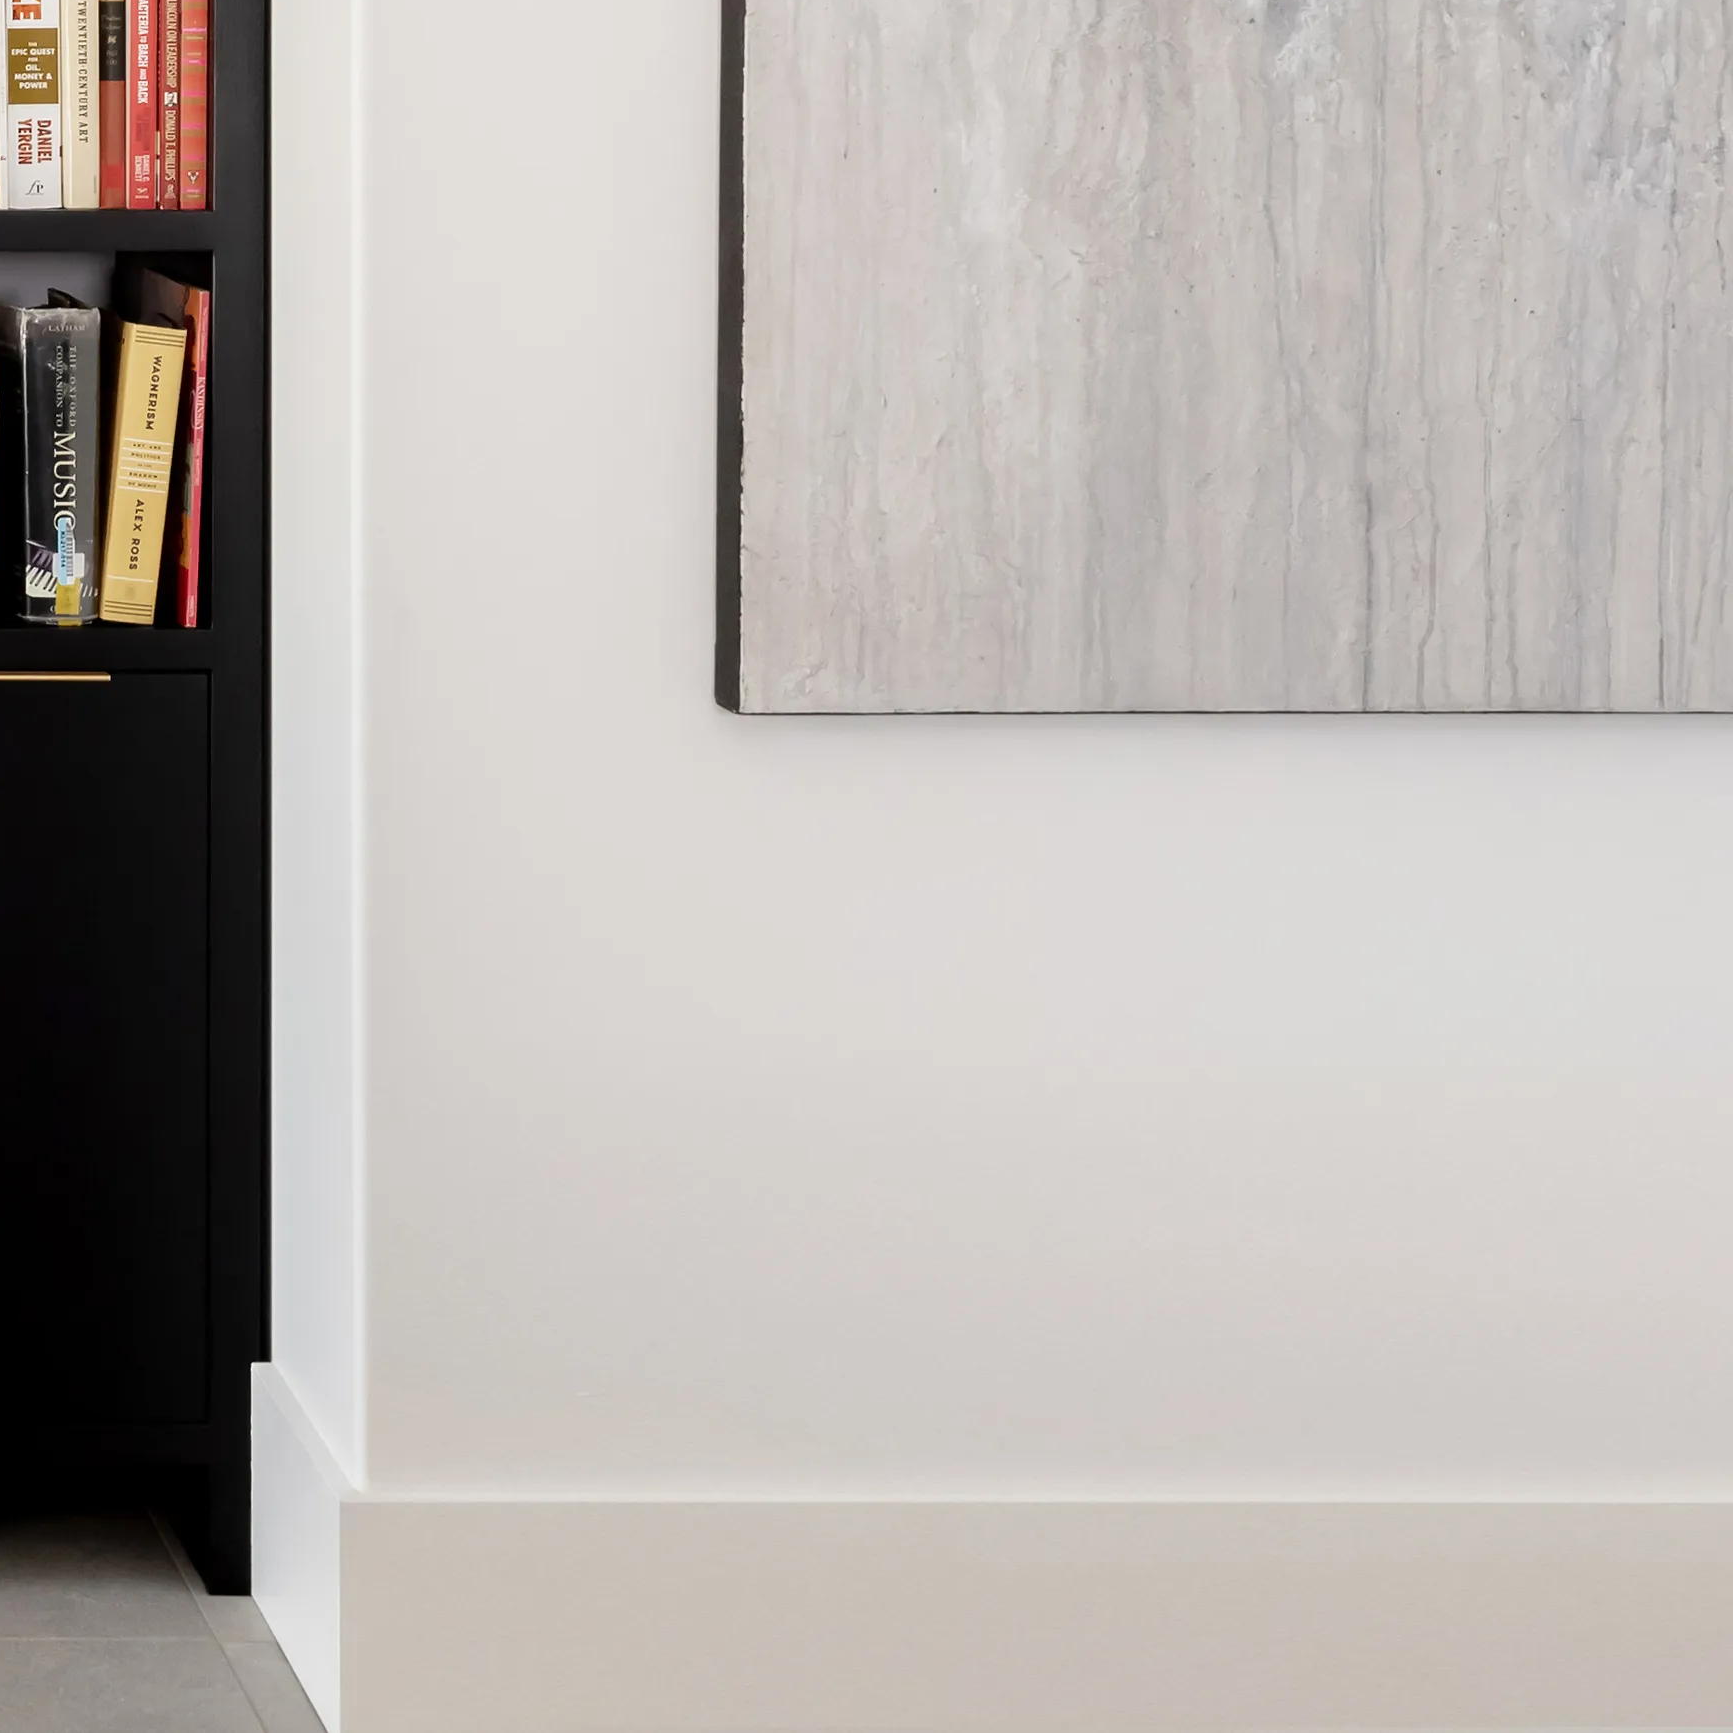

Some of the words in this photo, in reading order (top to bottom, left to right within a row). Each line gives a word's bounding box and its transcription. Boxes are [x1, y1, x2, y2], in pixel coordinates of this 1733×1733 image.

[18, 119, 32, 165] YERGIN
[37, 120, 52, 163] DANIEL
[145, 356, 162, 430] WAGNERISM
[134, 499, 144, 531] ALEX
[129, 538, 140, 570] ROSS
